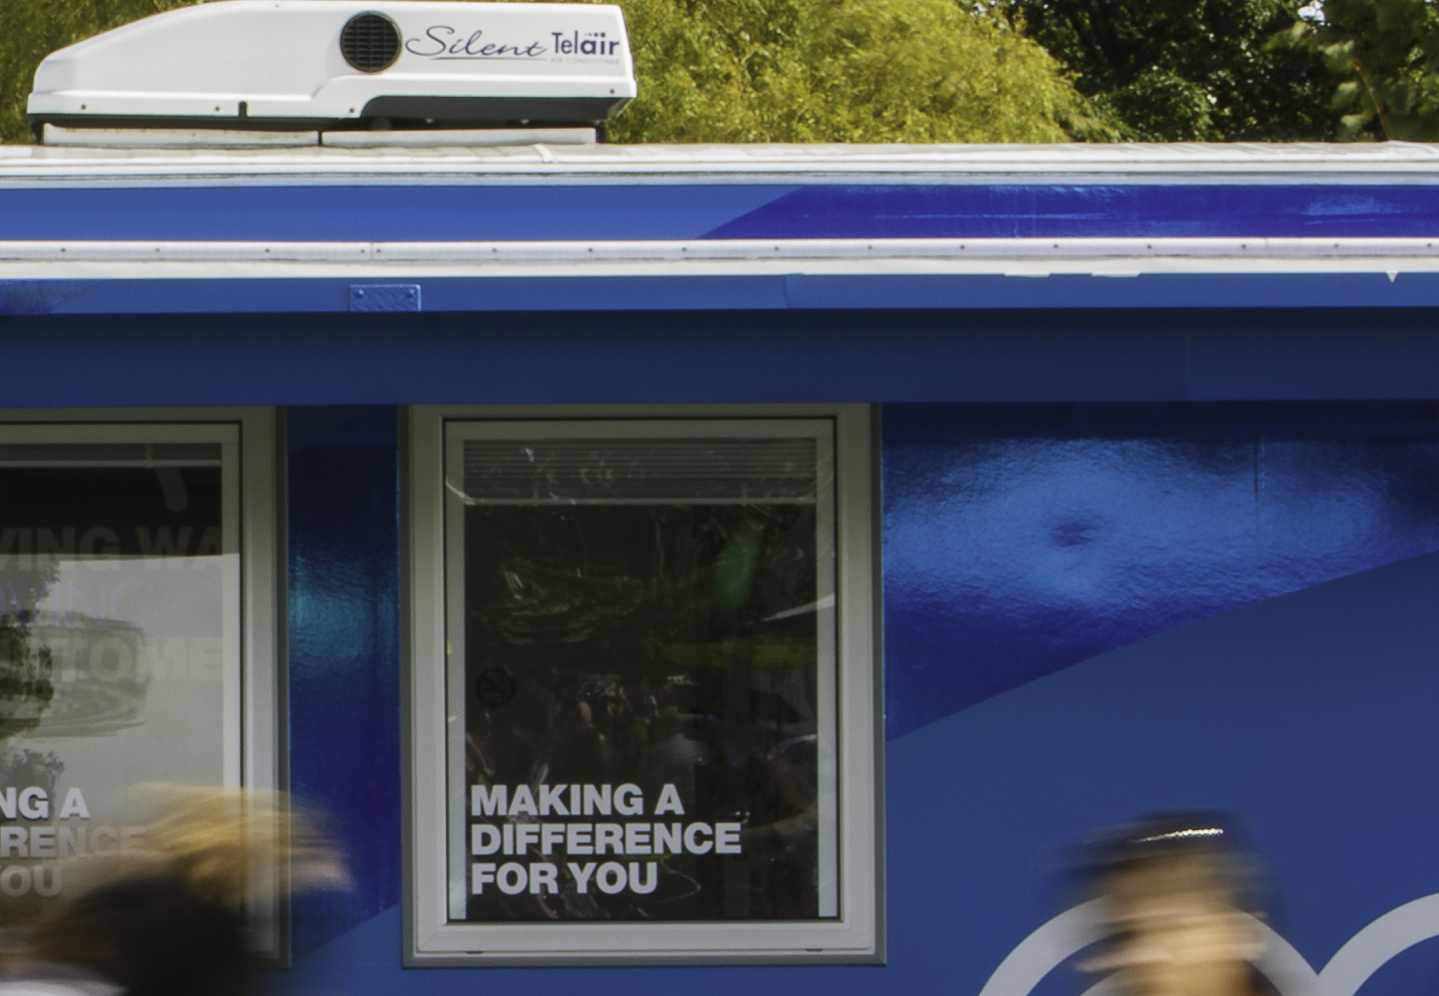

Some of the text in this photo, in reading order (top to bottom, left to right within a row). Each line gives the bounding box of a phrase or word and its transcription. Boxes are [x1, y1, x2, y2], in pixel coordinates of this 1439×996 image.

[405, 25, 547, 57] Silent
[59, 787, 90, 819] A
[471, 783, 684, 816] MAKING A
[471, 822, 742, 855] DIFFERENCE
[471, 862, 658, 895] FOR YOU
